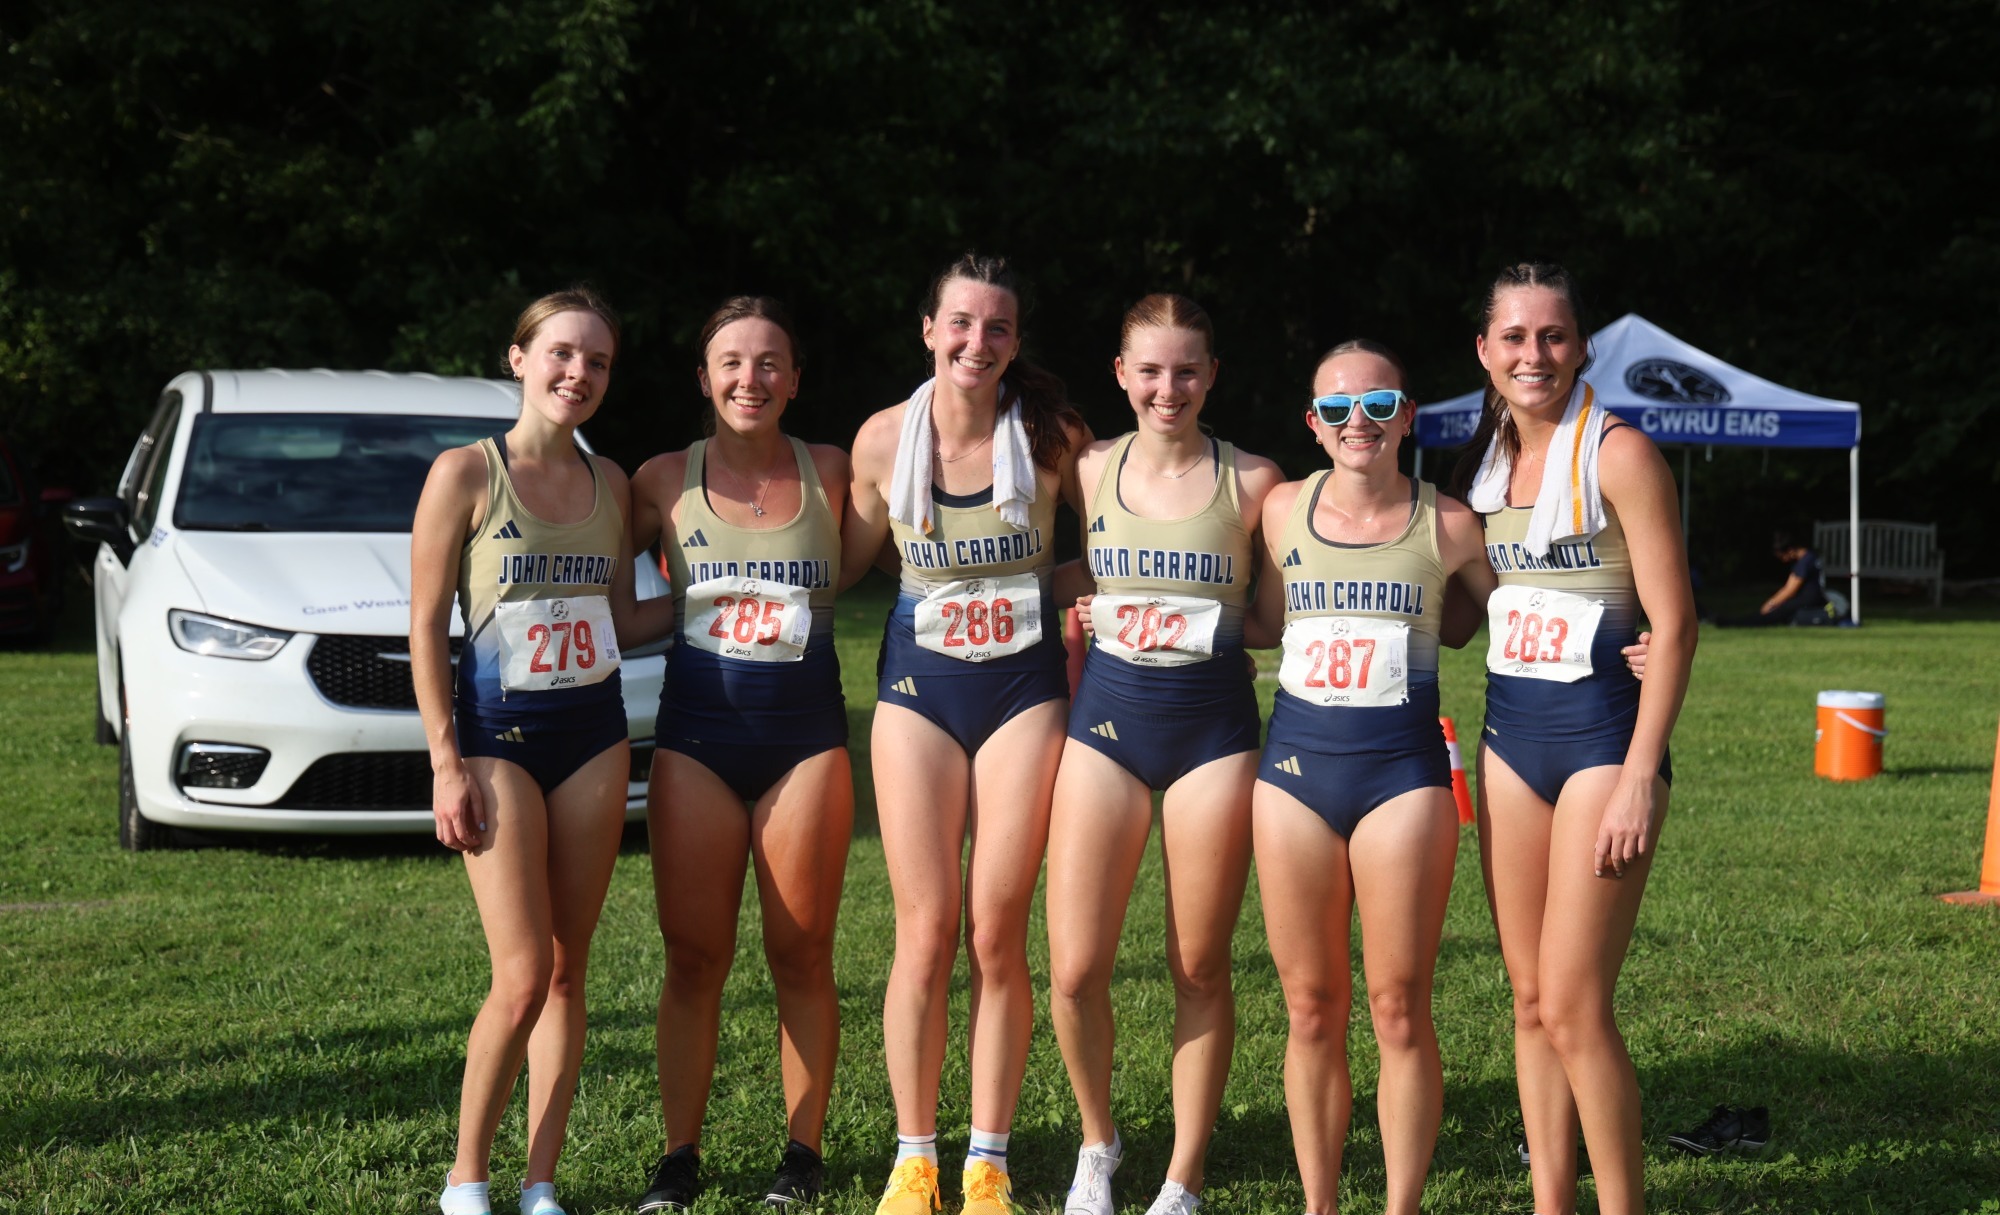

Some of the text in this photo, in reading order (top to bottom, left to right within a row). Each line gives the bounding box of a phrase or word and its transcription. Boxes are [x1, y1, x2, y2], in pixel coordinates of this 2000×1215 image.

[1640, 408, 1780, 438] CWRU EMS
[954, 528, 1043, 567] CARROLL
[1138, 549, 1234, 585] CARROLL
[498, 554, 548, 585] JOHN
[302, 604, 348, 615] Case
[1333, 580, 1424, 616] CARROLL
[708, 596, 785, 646] 285
[942, 598, 1014, 647] 286
[1117, 604, 1187, 652] 282
[1504, 609, 1569, 663] 283
[527, 620, 596, 673] 279
[1305, 639, 1376, 689] 287
